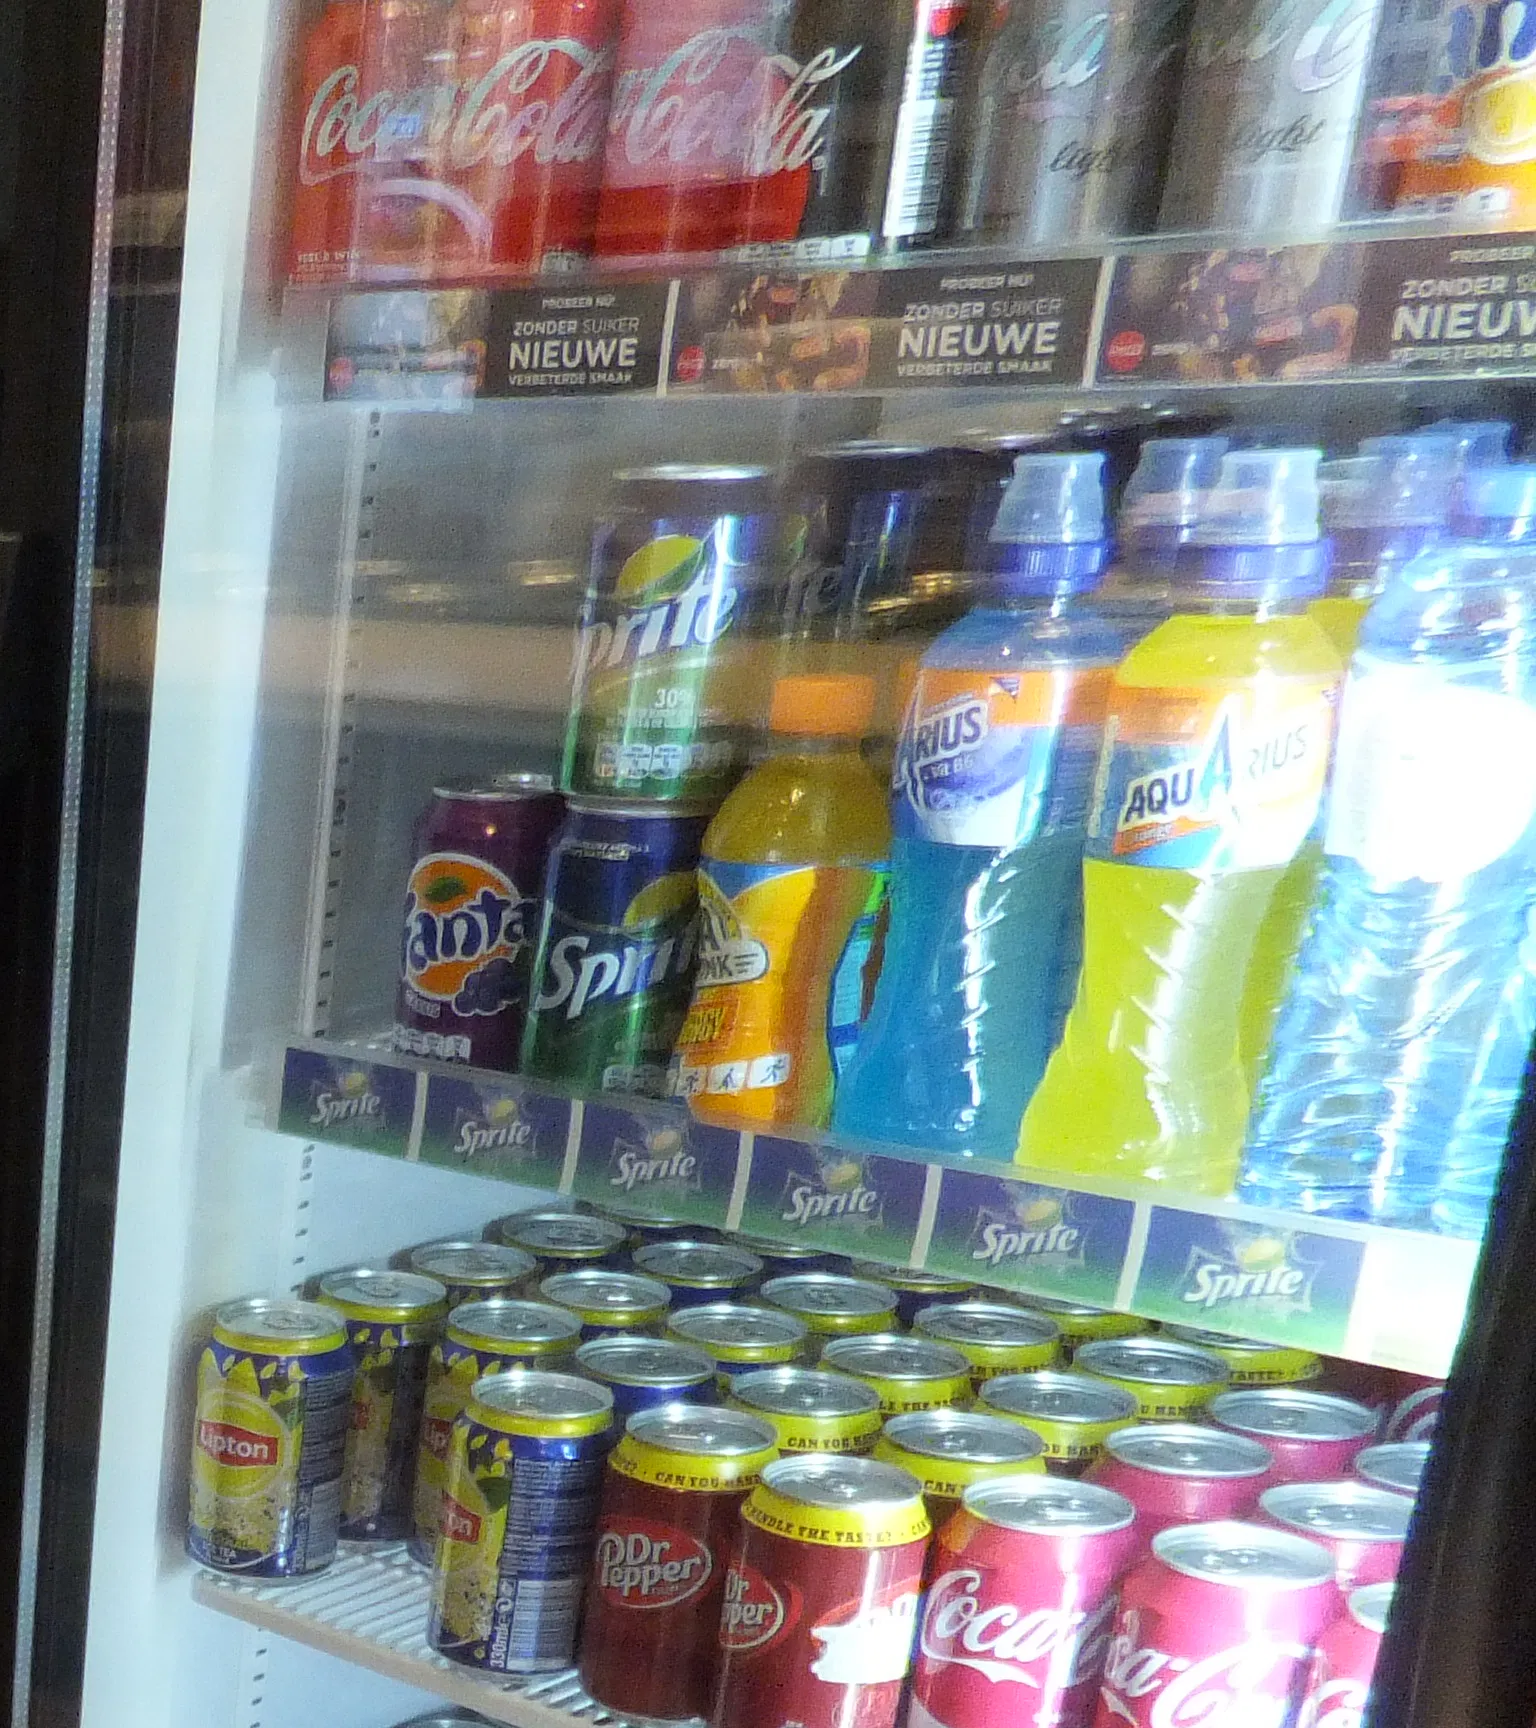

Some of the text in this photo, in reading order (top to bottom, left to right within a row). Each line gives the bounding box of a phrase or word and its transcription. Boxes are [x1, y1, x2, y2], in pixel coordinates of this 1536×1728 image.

[1401, 275, 1511, 300] ZONDER
[513, 317, 641, 337] ZONDER SUIKER
[903, 297, 1065, 324] ZONDER SUIKER
[1391, 299, 1536, 342] NIEU
[508, 337, 639, 371] NIEUWE
[897, 320, 1062, 360] NIEUWE
[568, 562, 739, 682] prite
[309, 1088, 382, 1128] Sprite
[453, 1116, 531, 1156] Sprite
[611, 1148, 697, 1190] Sprite
[782, 1182, 878, 1226] Sprite
[972, 1221, 1079, 1265] Sprite
[1185, 1261, 1305, 1307] Sprite
[787, 1436, 818, 1449] CAN
[655, 1472, 685, 1488] CAN
[688, 1476, 720, 1489] YOU
[924, 1479, 958, 1494] CAN
[627, 1532, 670, 1564] Dr
[797, 1525, 830, 1542] THE
[597, 1536, 702, 1598] Pepper
[722, 1599, 774, 1632] per
